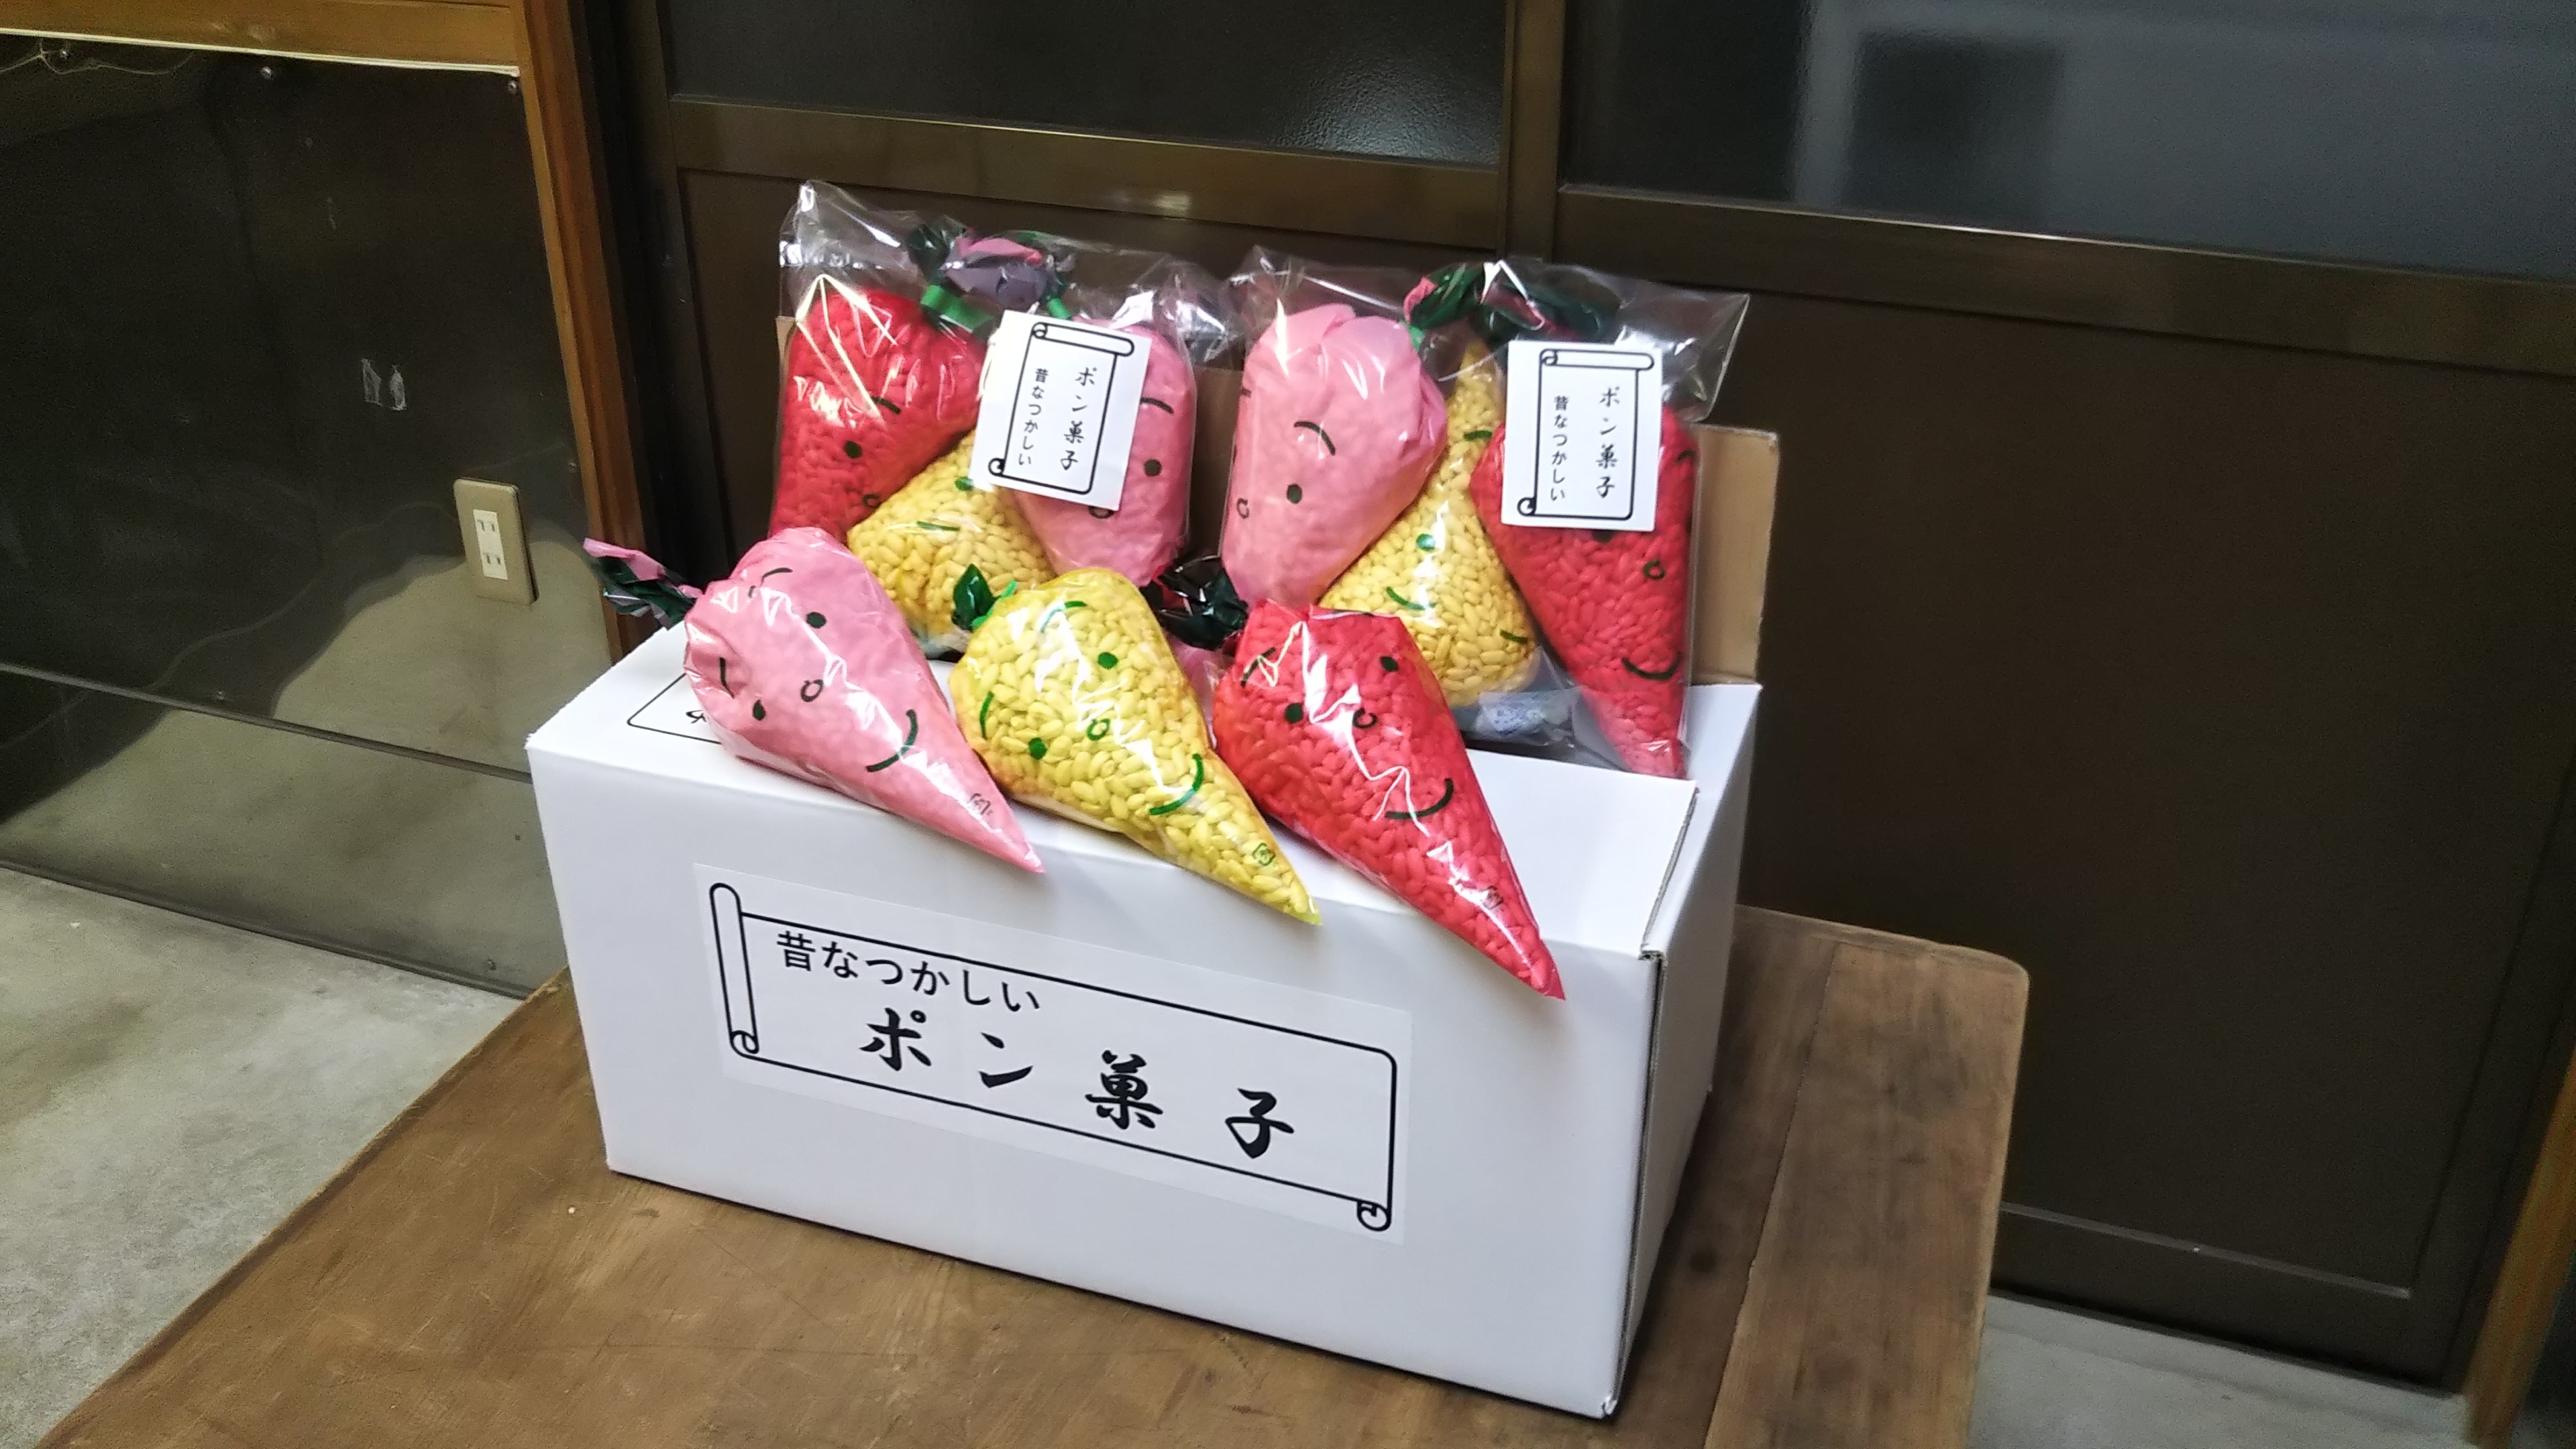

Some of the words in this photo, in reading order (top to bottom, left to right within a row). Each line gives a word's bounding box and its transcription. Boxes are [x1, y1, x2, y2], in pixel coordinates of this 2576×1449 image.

[1018, 368, 1049, 466] 昔なつかしい
[1060, 367, 1097, 471] ポン菓子
[1550, 395, 1569, 501] 昔なつかしい
[1596, 386, 1620, 498] ポン菓子
[776, 930, 1040, 1013] 昔なつかしい
[859, 1007, 1295, 1160] ポン菓子
